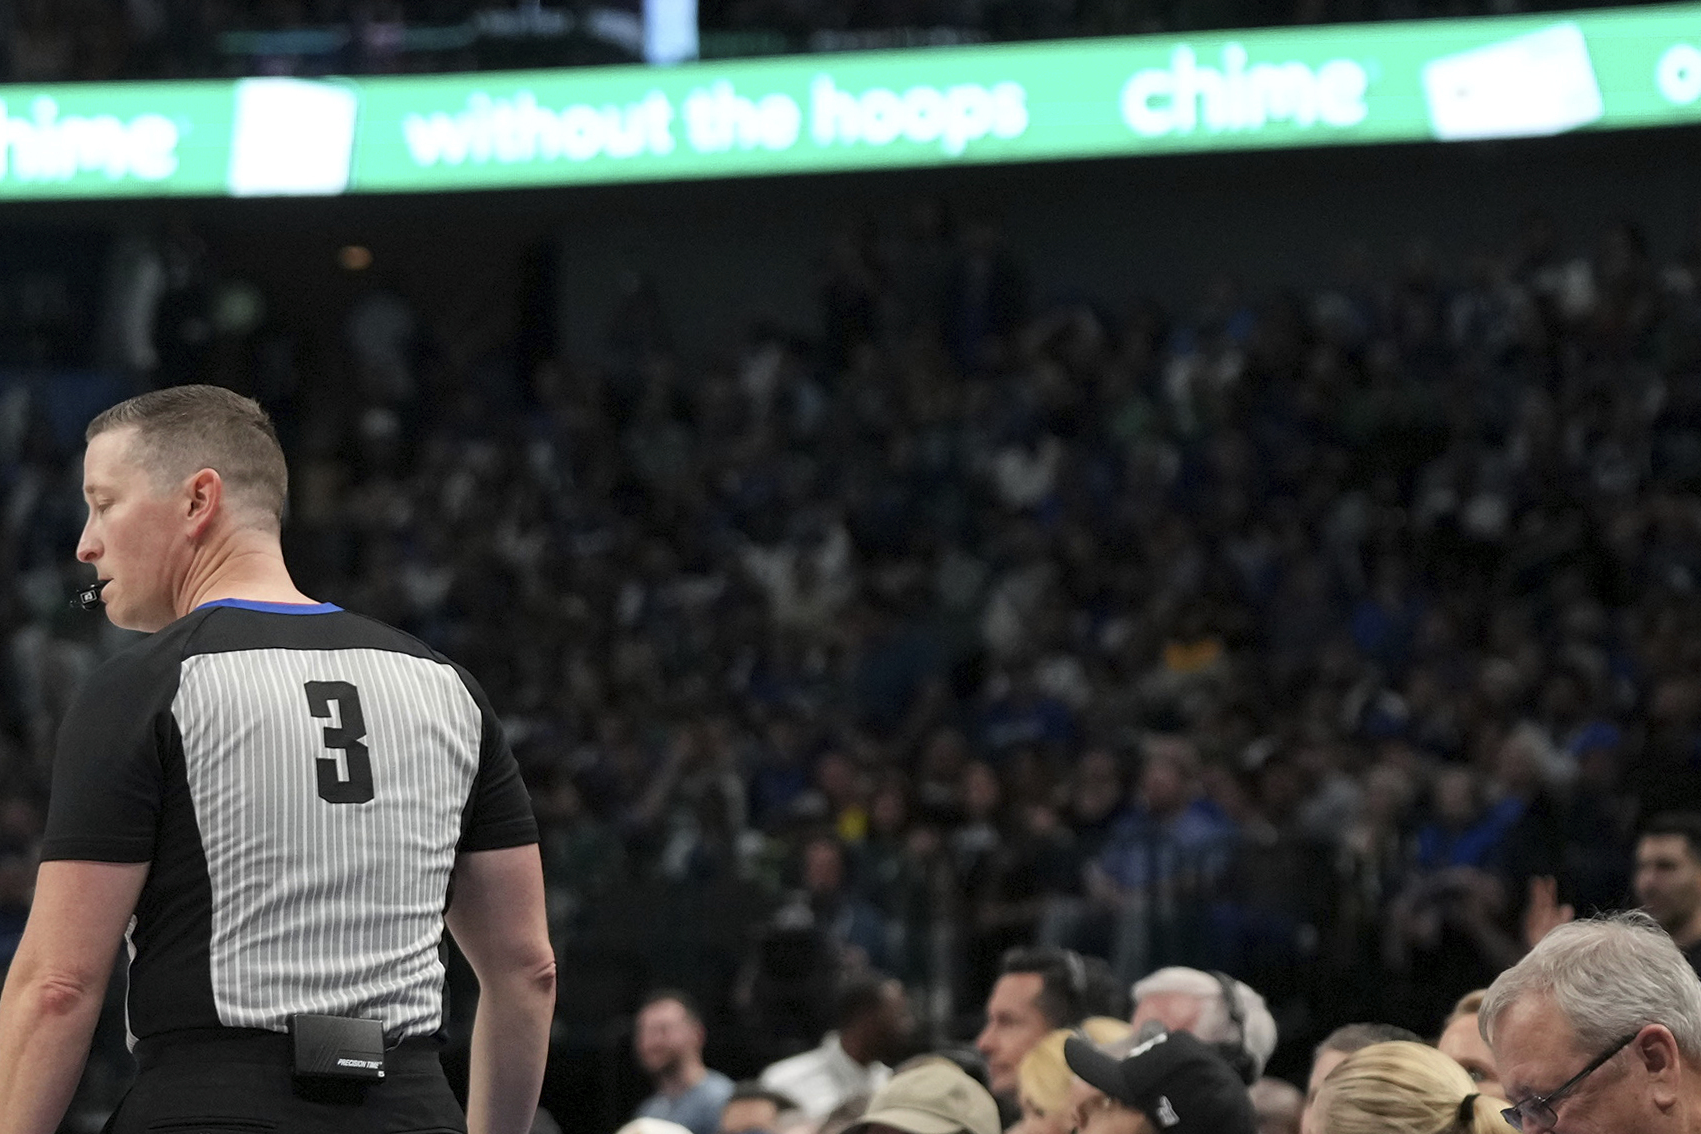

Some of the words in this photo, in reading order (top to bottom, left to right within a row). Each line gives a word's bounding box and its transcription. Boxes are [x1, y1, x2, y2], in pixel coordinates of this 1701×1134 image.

[402, 87, 676, 167] without
[682, 77, 801, 153] the
[808, 72, 1030, 155] hoops
[1122, 42, 1369, 138] chime
[304, 680, 374, 804] 3
[337, 1058, 367, 1068] PRECISION
